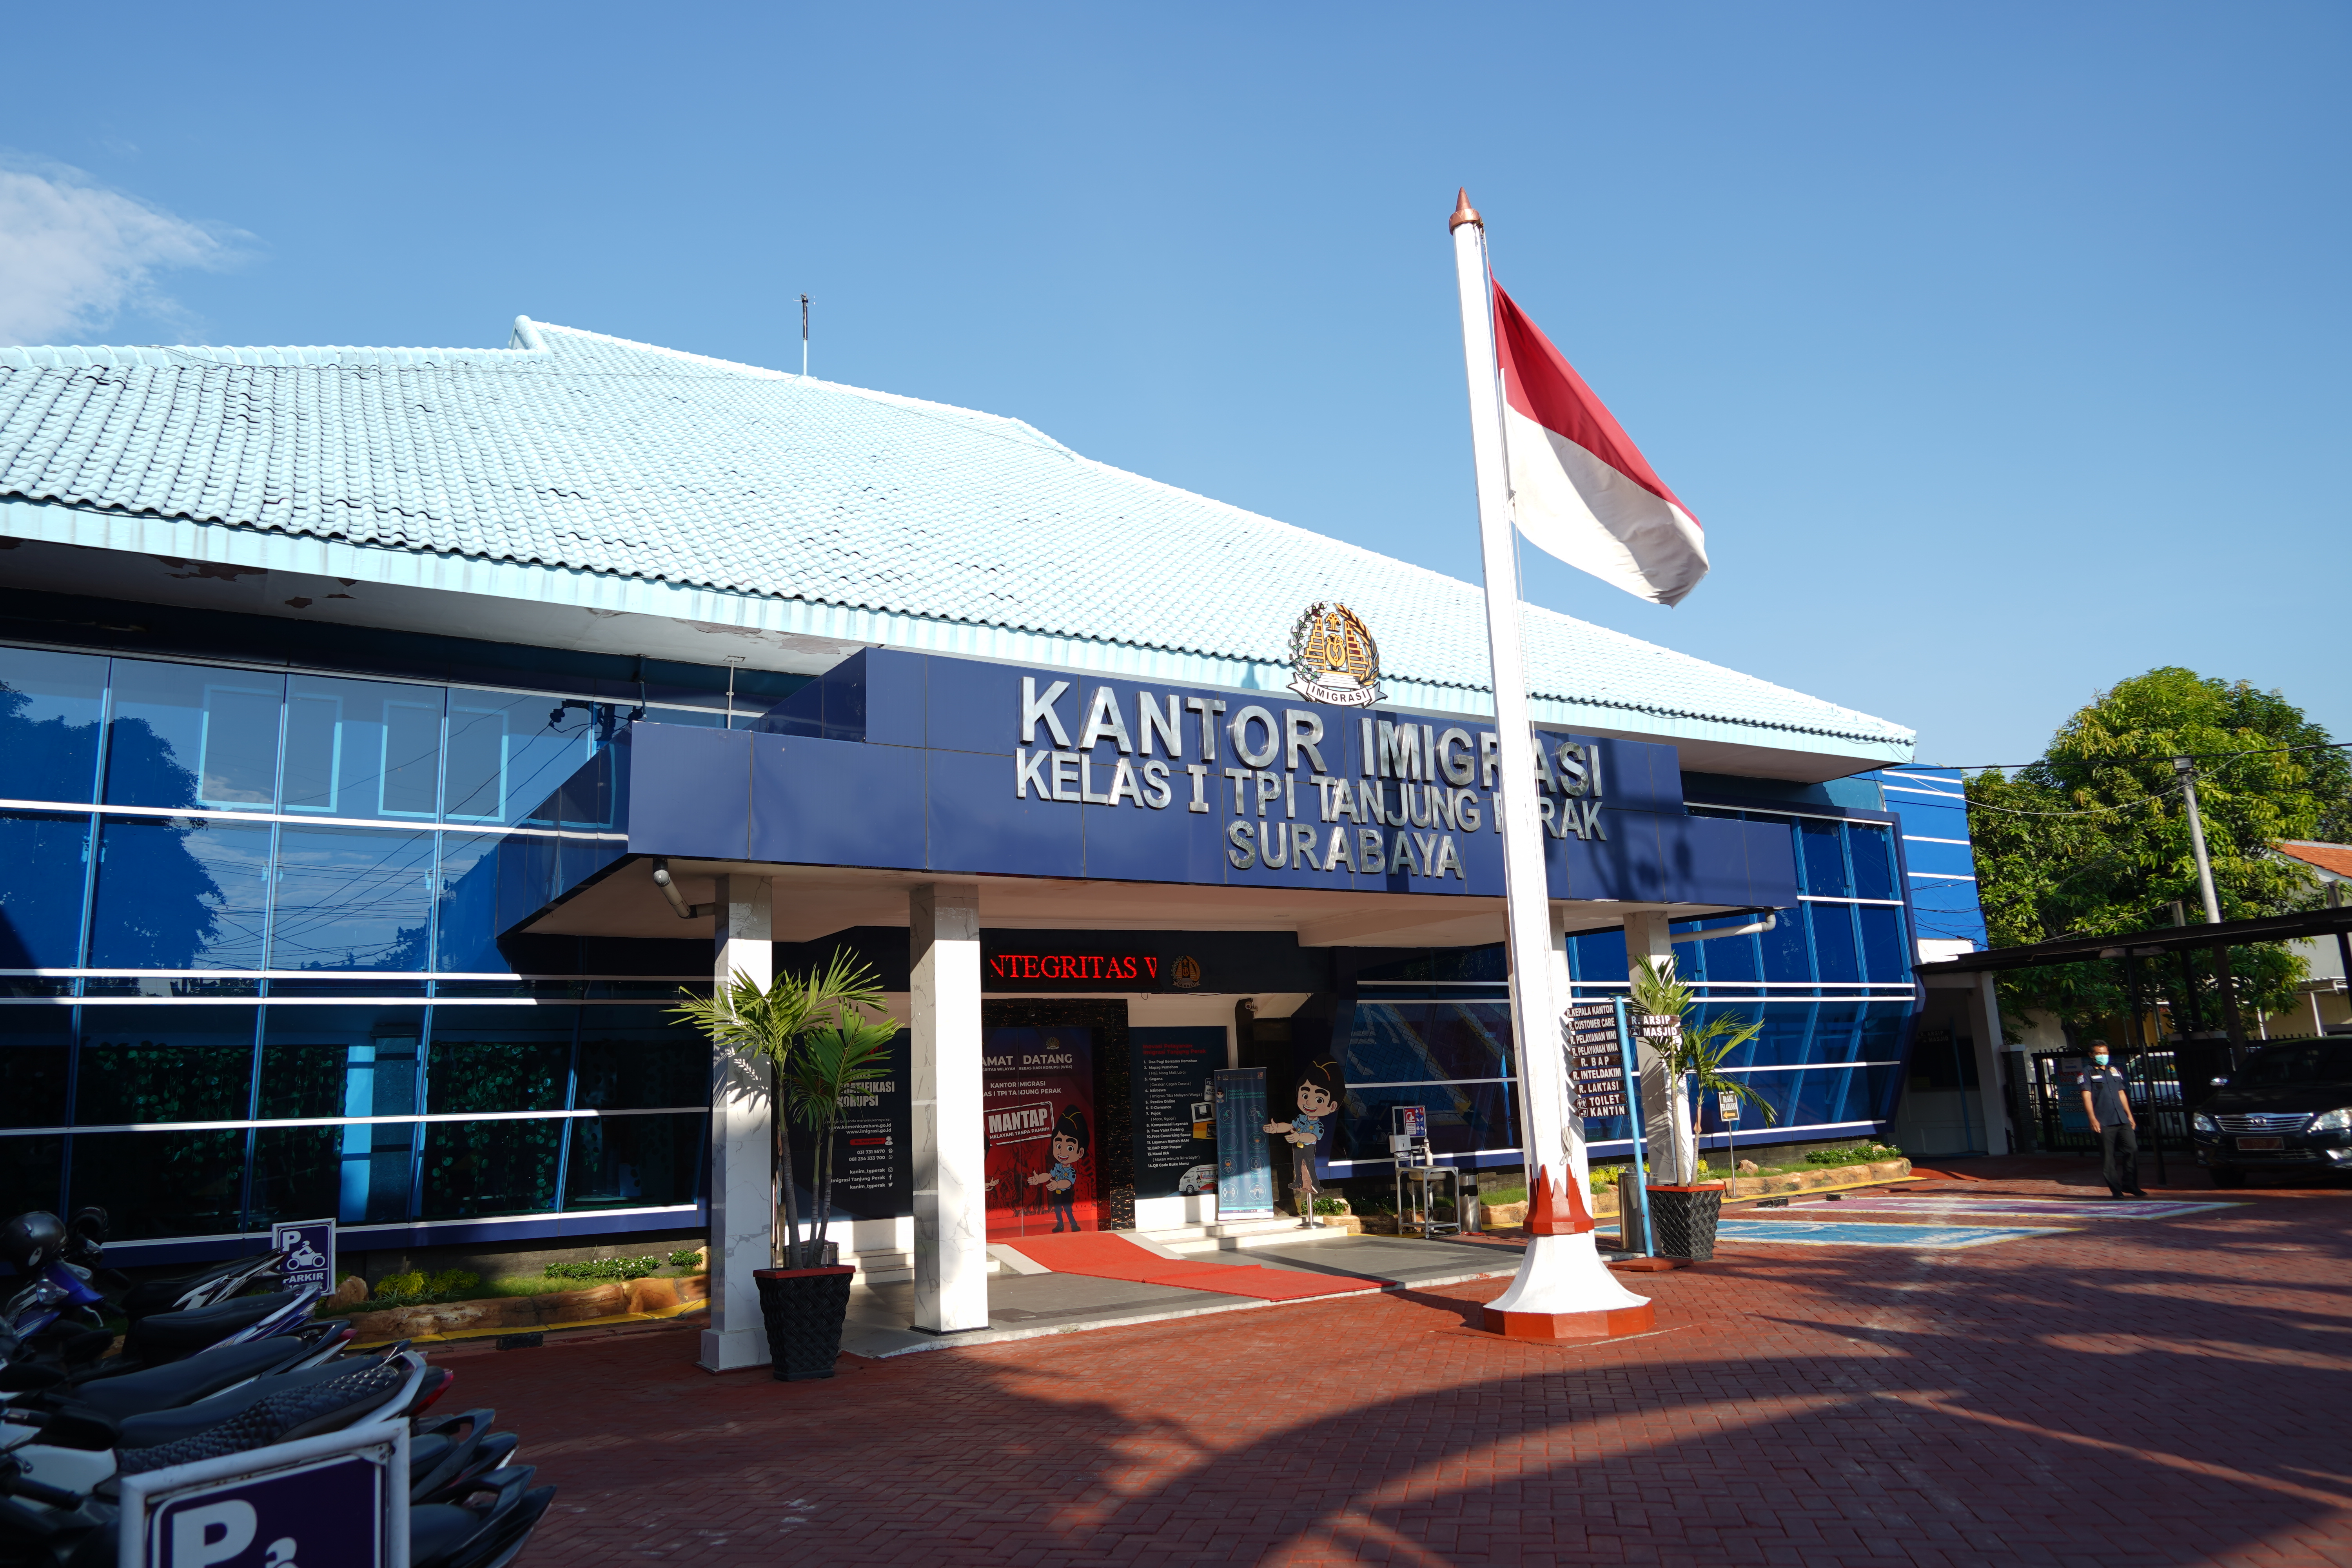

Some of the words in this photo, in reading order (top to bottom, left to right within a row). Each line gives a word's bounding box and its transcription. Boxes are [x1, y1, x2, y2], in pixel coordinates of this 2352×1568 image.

[1311, 685, 1367, 702] IMIGRASI
[1019, 676, 1327, 773] KANTOR
[1015, 748, 1171, 810] KELAS
[1186, 764, 1209, 814] I
[1224, 768, 1296, 819] TPI
[1309, 775, 1481, 833] TANJUNG
[1227, 820, 1464, 880] SURABAYA
[1592, 1004, 1613, 1014] KANTOR
[1568, 1021, 1574, 1030] R.
[1574, 1019, 1600, 1029] CUSTOMER
[1601, 1017, 1615, 1027] CARE
[1631, 1016, 1641, 1025] R.
[1643, 1015, 1670, 1024] ARSIP
[1570, 1036, 1575, 1045] R.
[1576, 1032, 1605, 1044] PELAYANAN
[1606, 1030, 1617, 1040] WNI
[1643, 1027, 1677, 1036] MASJID
[1572, 1047, 1577, 1056] R.
[1578, 1045, 1606, 1055] PELAYANAN
[1606, 1043, 1618, 1052] WNA
[1023, 1054, 1073, 1065] DATANG
[1581, 1058, 1588, 1067] R.
[1573, 1071, 1580, 1080] R.
[1581, 1067, 1621, 1080] INTELDAKIM
[1579, 1084, 1586, 1094] R.
[1588, 1081, 1619, 1093] LAKTASI
[837, 1095, 878, 1107] KORUPSI
[1589, 1094, 1619, 1106] TOILET
[1590, 1105, 1625, 1117] KANTIN
[988, 1108, 1048, 1133] MANTAP
[282, 1230, 301, 1252] P
